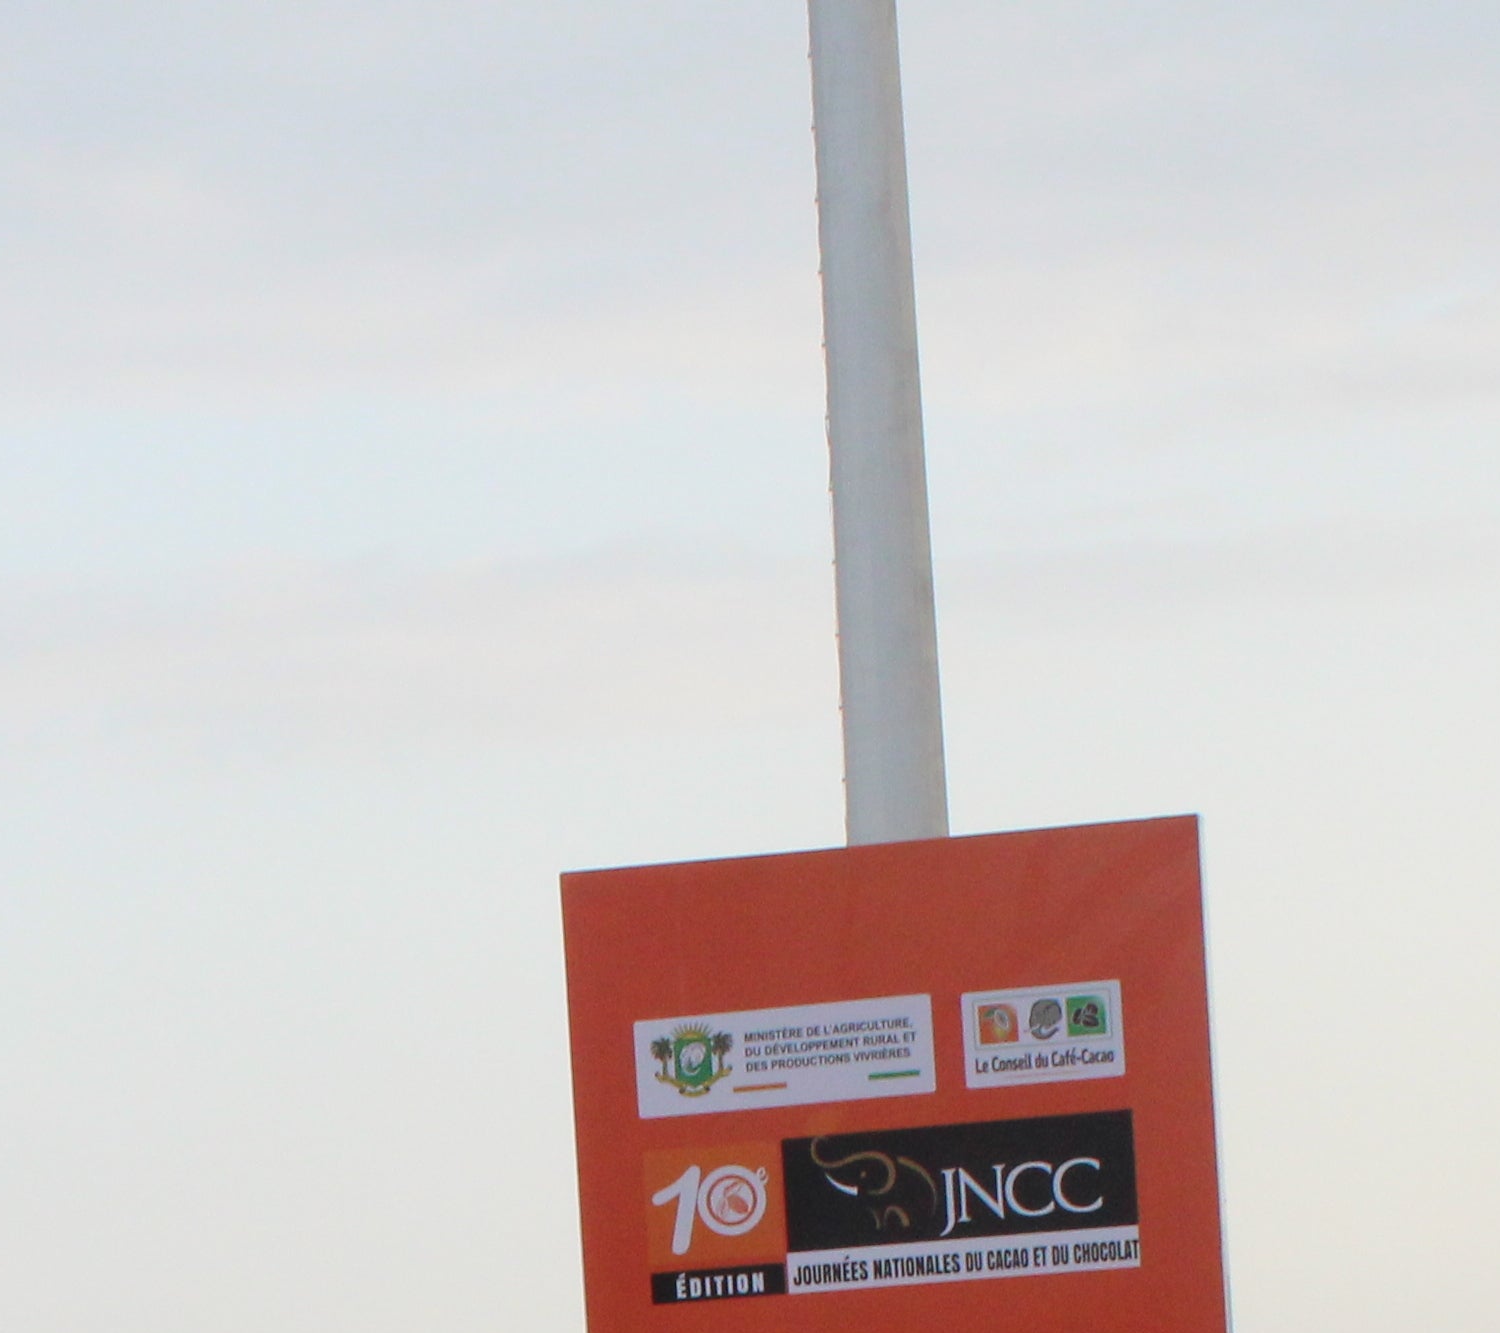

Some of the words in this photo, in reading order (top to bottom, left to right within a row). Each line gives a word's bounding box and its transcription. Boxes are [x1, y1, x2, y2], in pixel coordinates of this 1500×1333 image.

[744, 1027, 801, 1042] MINISTÈRE
[806, 1027, 820, 1037] DE
[745, 1047, 761, 1057] DU
[765, 1038, 859, 1056] DÉVELOPPEMENT
[863, 1033, 899, 1045] RURAL
[903, 1031, 916, 1042] ET
[746, 1062, 768, 1072] DES
[771, 1053, 850, 1071] PRODUCTIONS
[853, 1046, 911, 1062] VIVRIÈRES
[975, 1058, 988, 1073] Le
[992, 1053, 1032, 1071] Conseil
[1035, 1052, 1048, 1067] du
[1051, 1047, 1114, 1067] Café-Cacao
[939, 1157, 1103, 1237] JNCC
[793, 1256, 868, 1286] JOURNÉES
[873, 1253, 961, 1280] NATIONALES
[966, 1252, 982, 1271] DU
[987, 1248, 1029, 1270] CACAO
[1033, 1246, 1047, 1267] ET
[1052, 1245, 1069, 1266] DU
[1073, 1239, 1139, 1263] CHOCOLAT
[675, 1271, 765, 1299] ÉDITION
